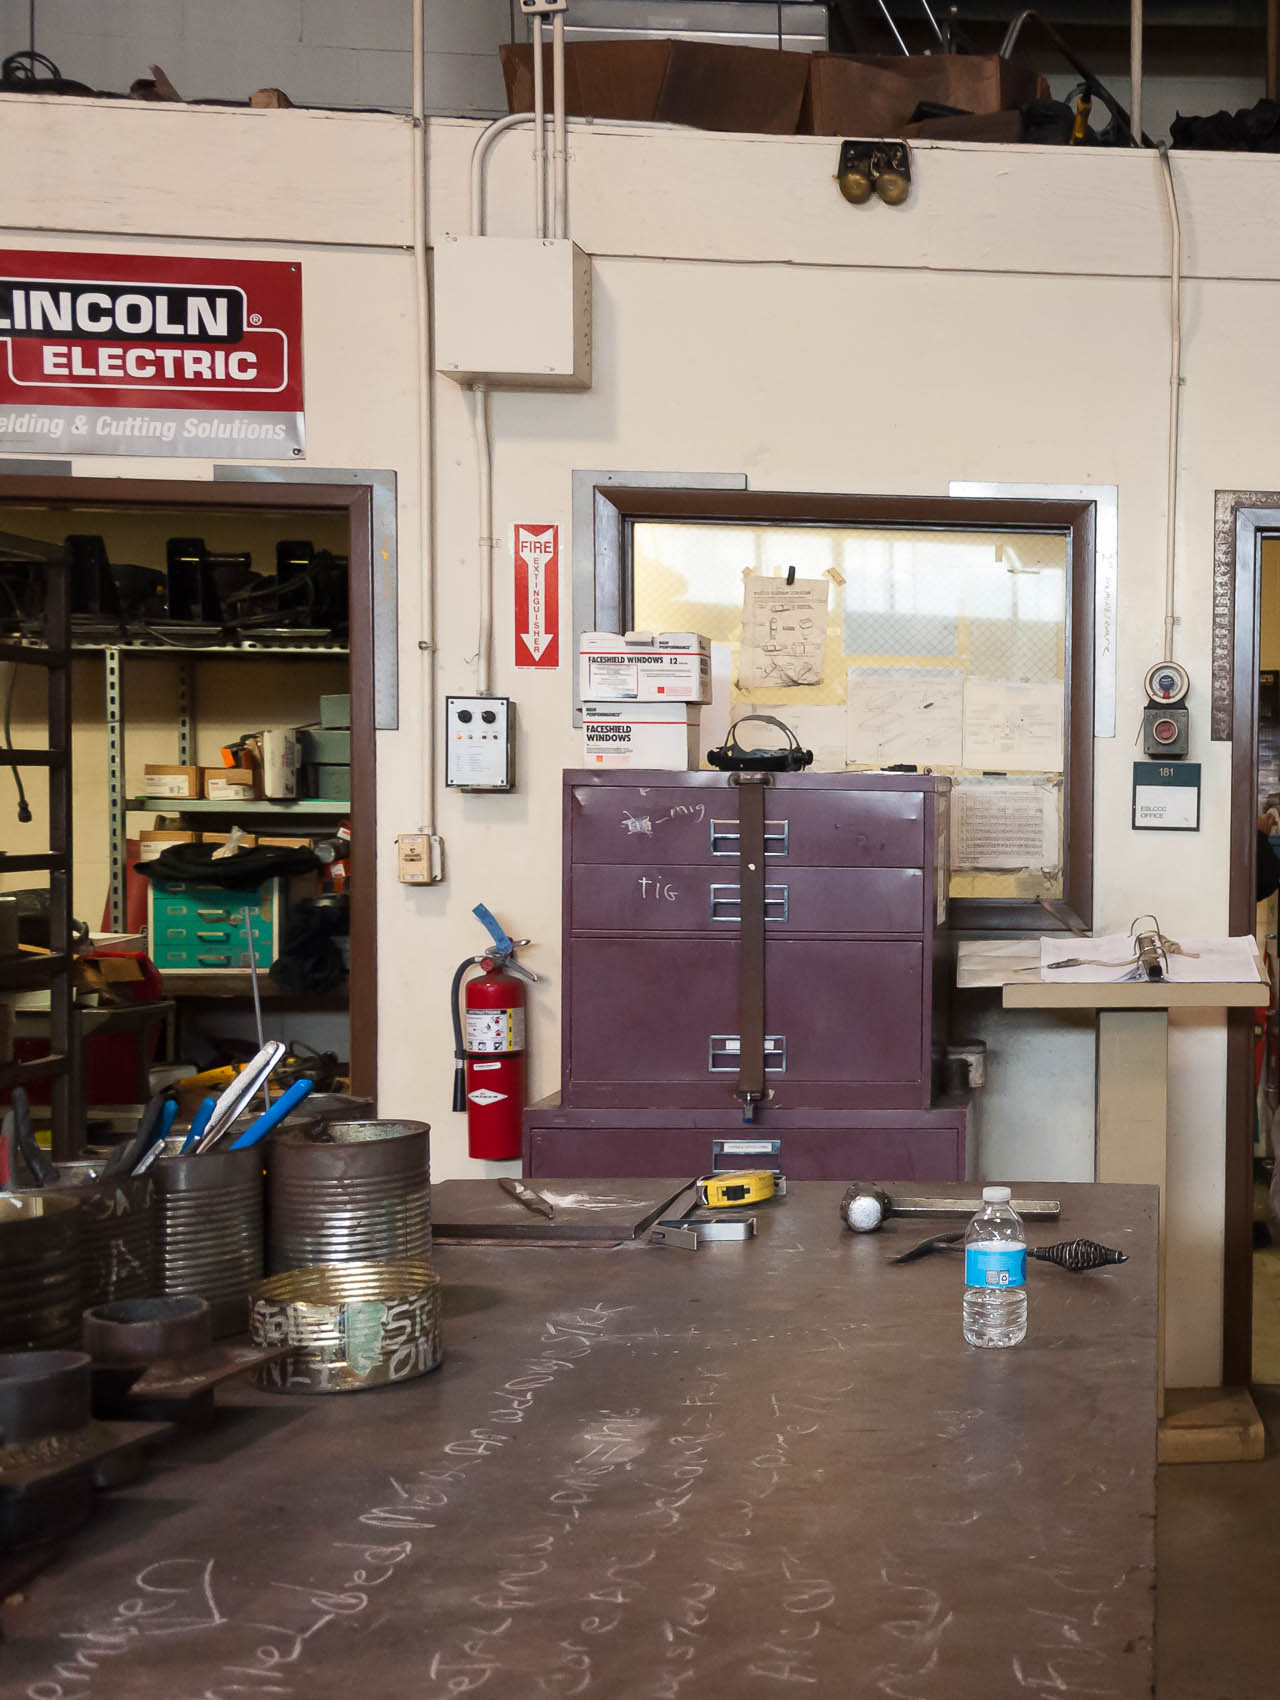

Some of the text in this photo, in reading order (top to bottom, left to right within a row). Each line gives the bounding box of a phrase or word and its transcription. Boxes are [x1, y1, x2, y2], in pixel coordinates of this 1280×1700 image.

[42, 345, 258, 380] ELECTRIC
[71, 415, 89, 435] &
[96, 415, 176, 442] Cutting
[182, 418, 287, 440] Solutions
[520, 541, 553, 554] FIRE
[532, 557, 540, 653] EXTINGUISHER
[588, 655, 678, 665] FACESHIELD WINDOWS 12
[586, 725, 632, 734] FACESHIELD
[586, 734, 631, 742] WINDOWS
[1159, 767, 1174, 777] 181
